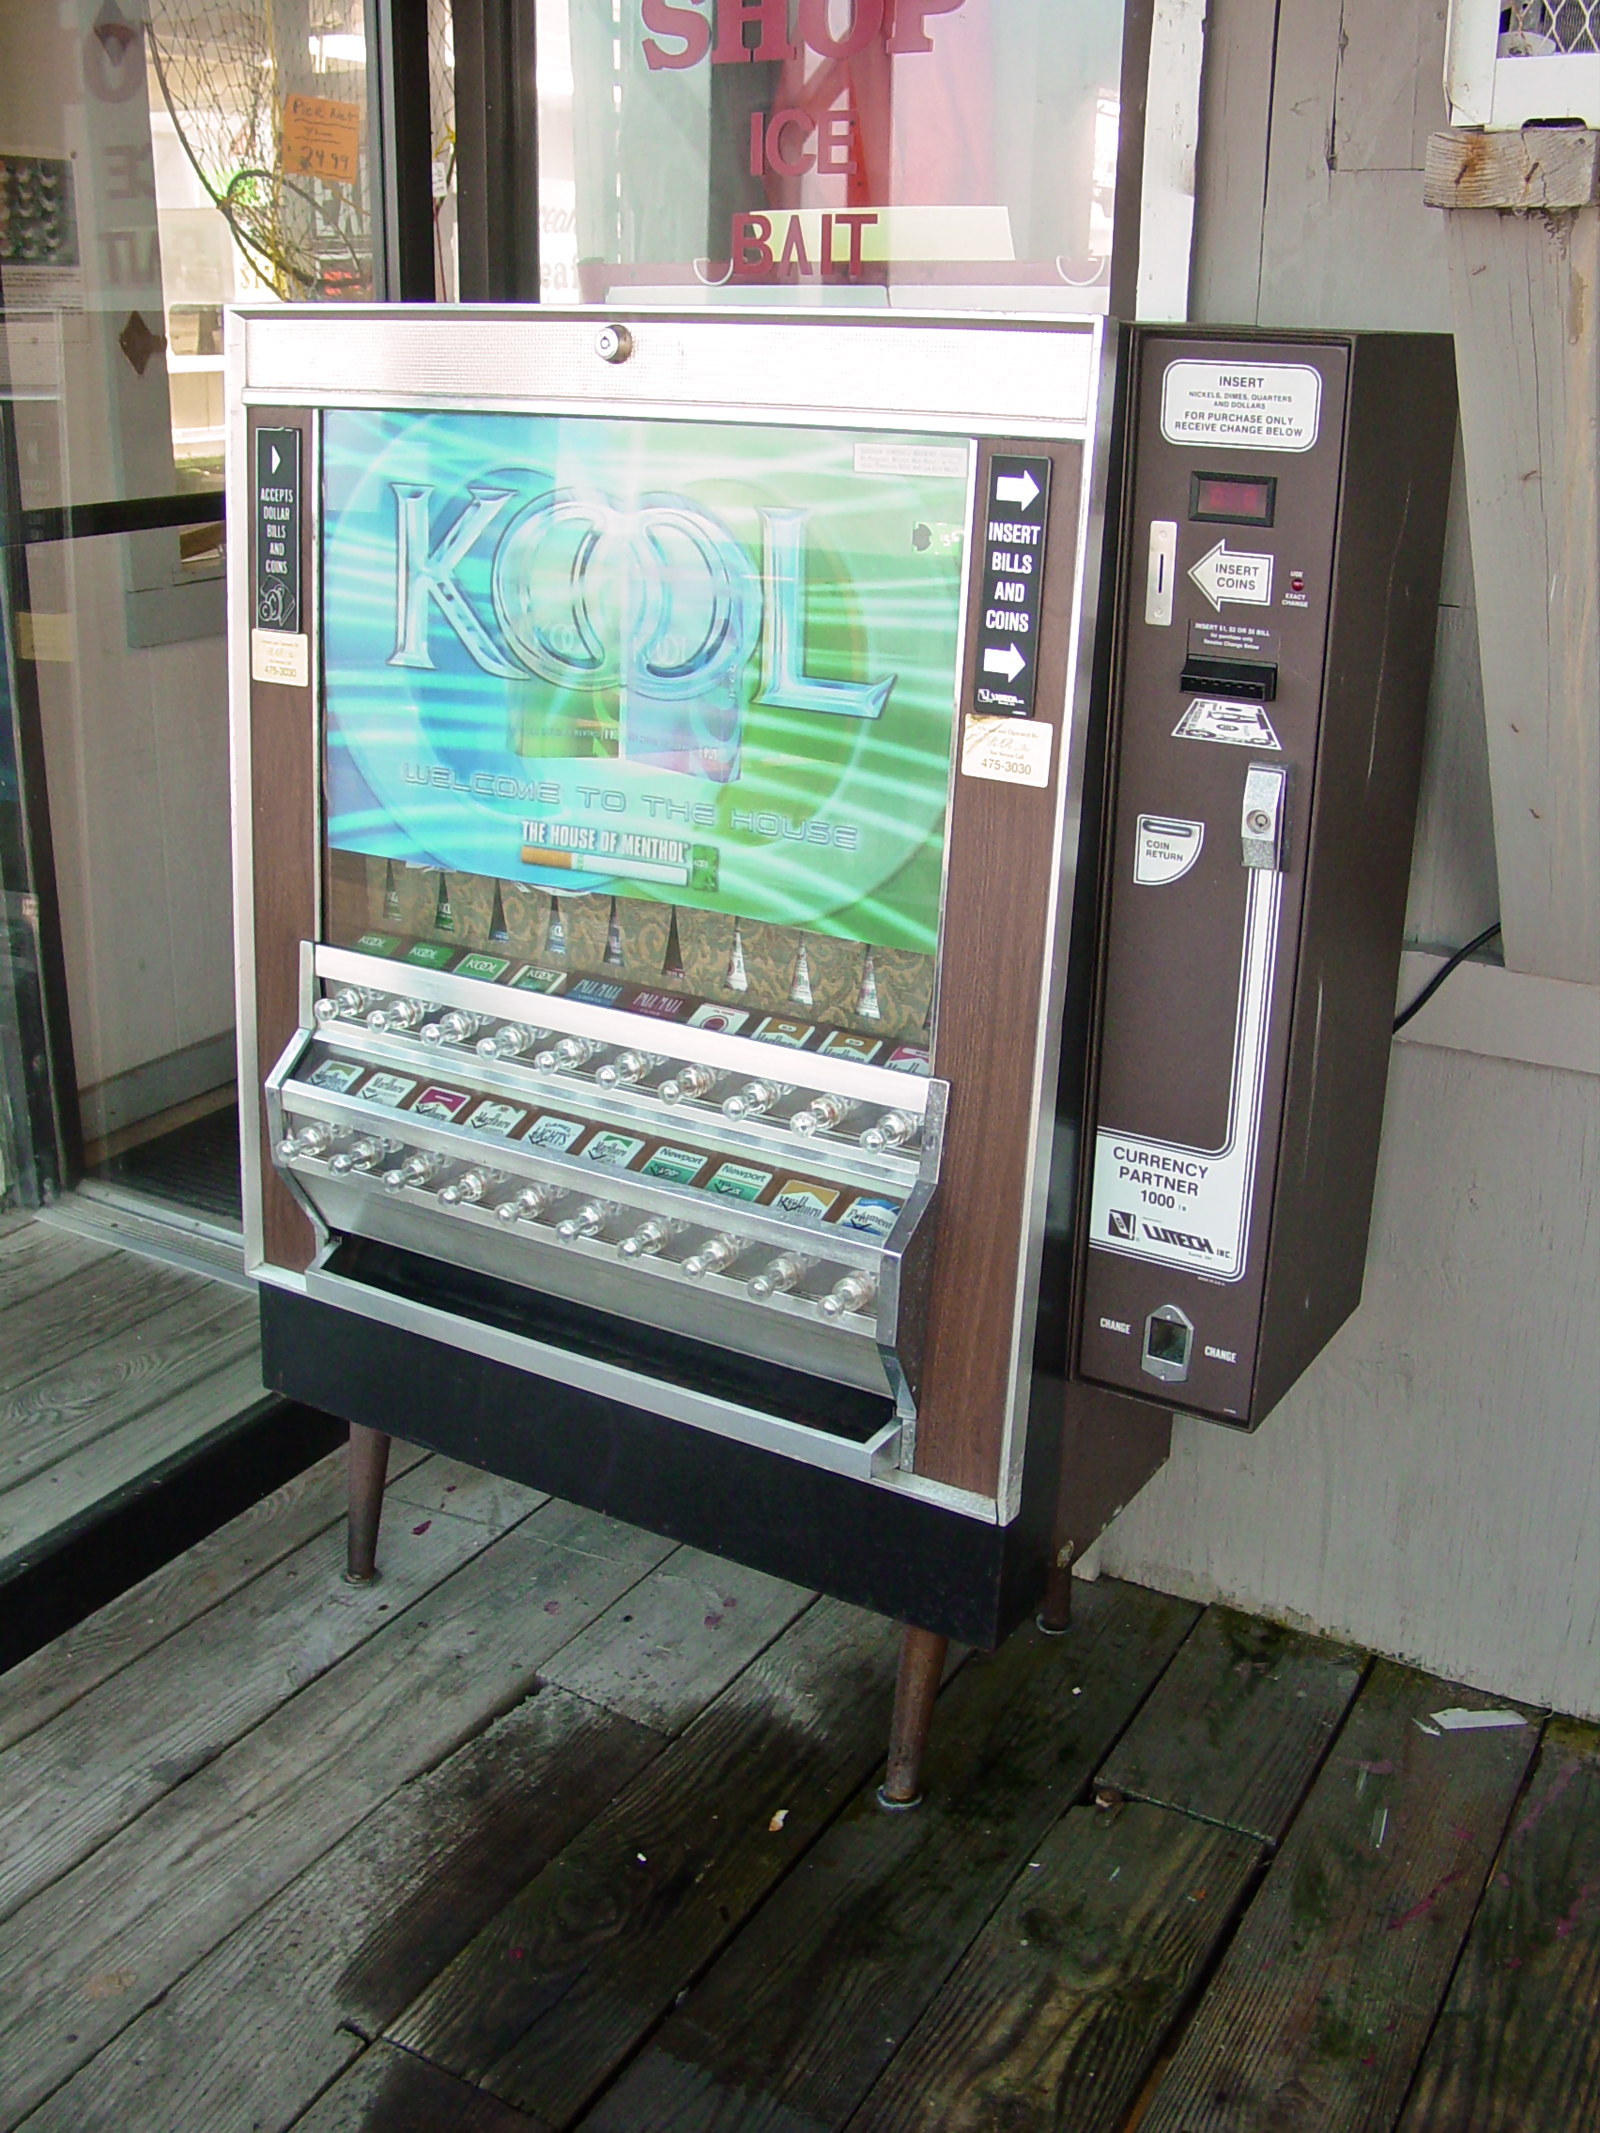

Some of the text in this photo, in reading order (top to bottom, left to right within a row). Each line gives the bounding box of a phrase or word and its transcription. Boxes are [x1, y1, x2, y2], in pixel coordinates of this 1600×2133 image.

[750, 108, 857, 177] ICE
[731, 212, 879, 278] BAIT
[1219, 376, 1265, 388] INSERT
[1251, 394, 1292, 402] QUARTERS
[1184, 411, 1294, 425] FOR PURCHASE ONLY
[1174, 421, 1303, 437] RECEIVE CHANGE BELOW
[260, 487, 294, 503] ACCEPTS
[263, 505, 290, 521] DOLLAR
[266, 524, 286, 539] BILLS
[988, 521, 1041, 545] INSERT
[269, 542, 285, 557] AND
[265, 559, 288, 575] COINS
[991, 551, 1033, 574] BILLS
[1215, 563, 1260, 577] INSERT
[994, 581, 1025, 603] AND
[1216, 577, 1256, 591] COINS
[985, 609, 1029, 633] COINS
[264, 665, 298, 678] 475-3030
[981, 758, 1032, 775] 475-3030
[403, 761, 860, 850] WELCOME TO THE HOUSE
[521, 820, 547, 843] THE
[550, 825, 597, 850] HOUSE
[600, 831, 618, 853] OF
[1146, 839, 1170, 851] COIN
[1145, 849, 1184, 862] RETURN
[358, 935, 386, 948] KOOL
[409, 946, 438, 960] KOOL
[466, 958, 498, 974] KOOL
[526, 968, 555, 982] KOOL
[660, 1147, 704, 1165] Newport
[1113, 1146, 1209, 1180] CURRENCY
[721, 1164, 767, 1182] Newport
[1118, 1165, 1199, 1197] PARTNER
[1140, 1189, 1176, 1209] 1000
[1141, 1222, 1215, 1255] LUTECH
[1100, 1317, 1131, 1335] CHANGE
[1204, 1345, 1237, 1364] CHANGE
